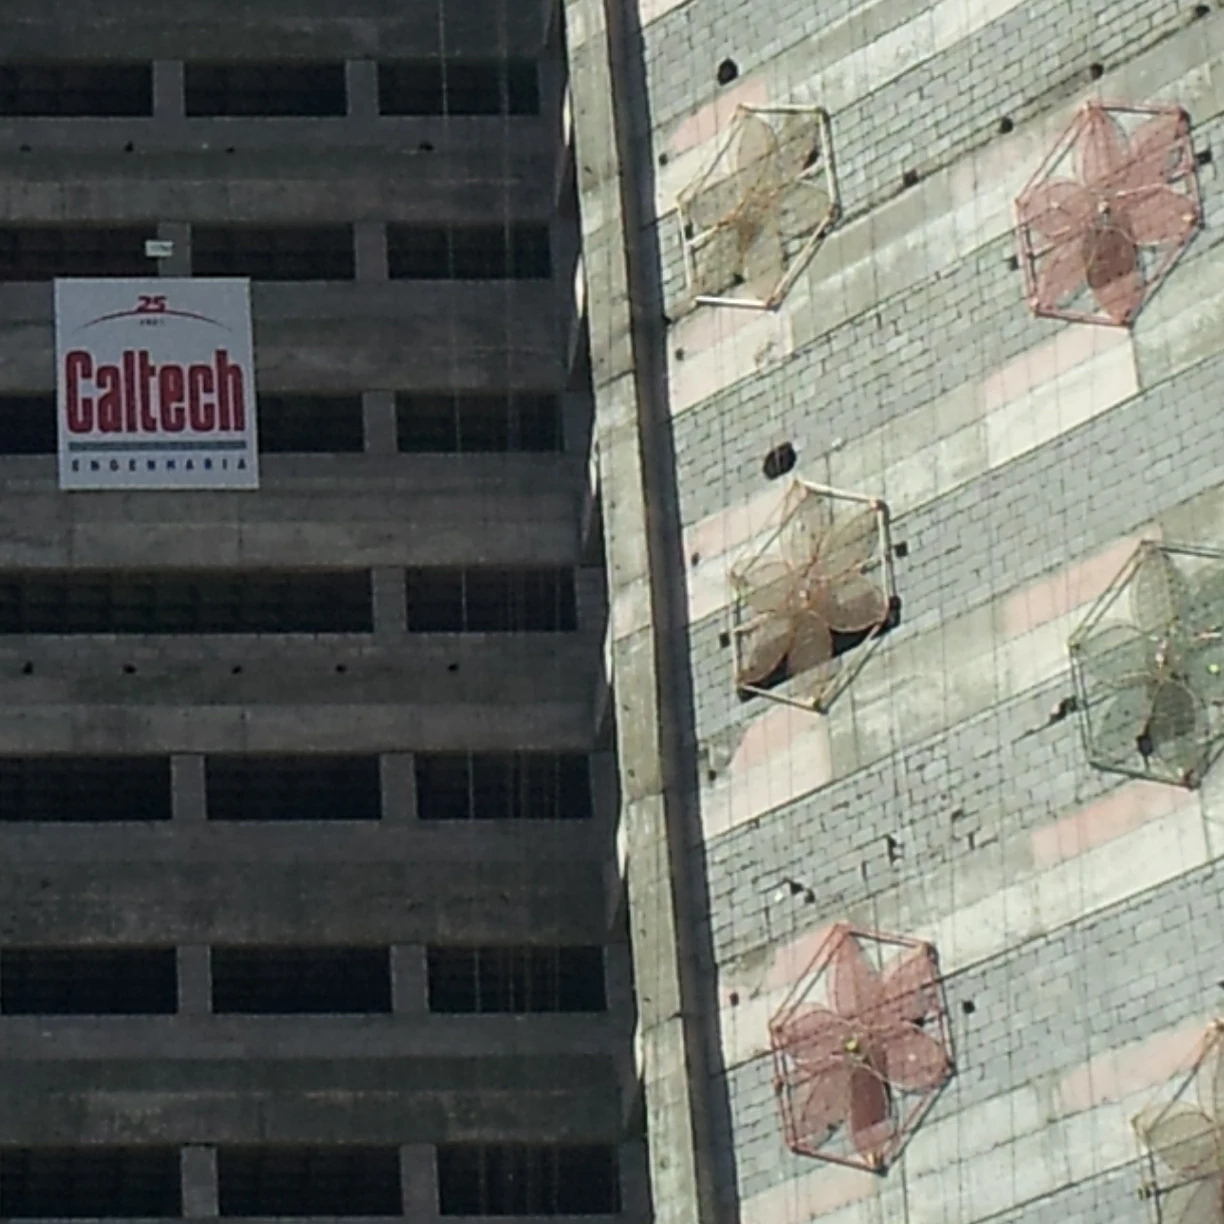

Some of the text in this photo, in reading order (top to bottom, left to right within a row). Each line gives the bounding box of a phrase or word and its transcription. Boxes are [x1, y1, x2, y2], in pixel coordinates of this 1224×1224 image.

[136, 295, 167, 314] 25
[66, 349, 245, 433] Caltech
[71, 458, 247, 473] ENGENHARIA
